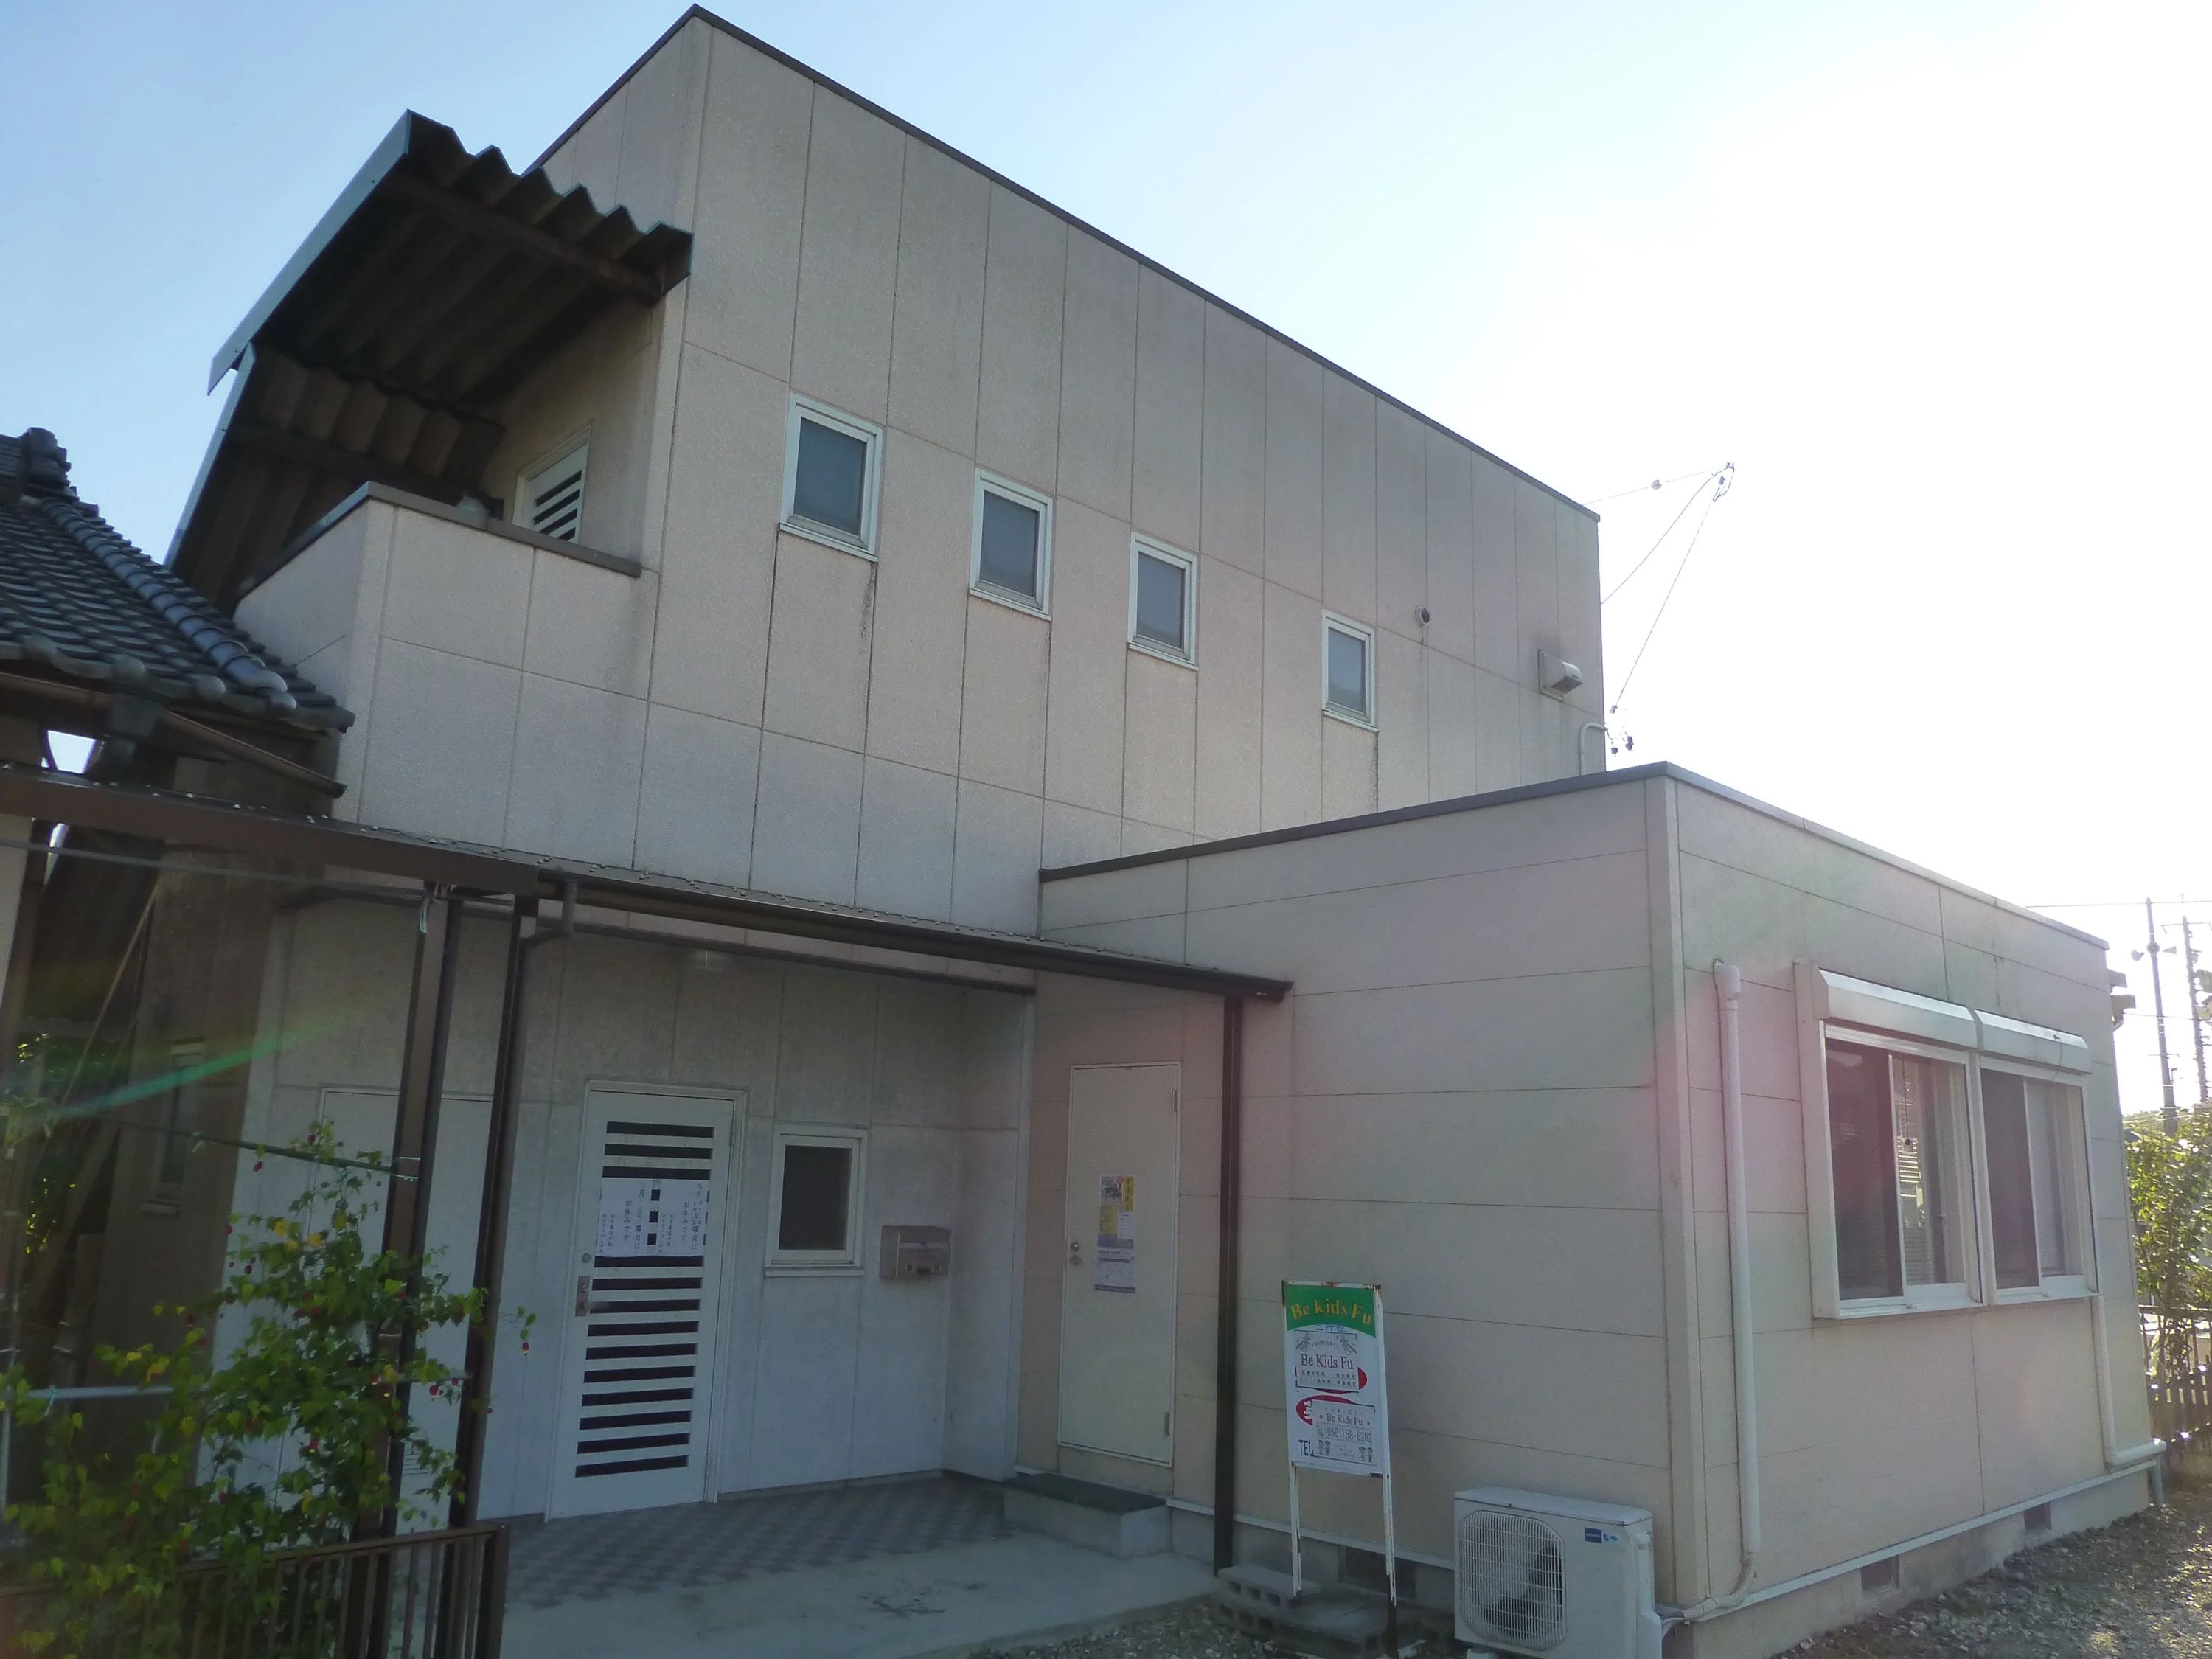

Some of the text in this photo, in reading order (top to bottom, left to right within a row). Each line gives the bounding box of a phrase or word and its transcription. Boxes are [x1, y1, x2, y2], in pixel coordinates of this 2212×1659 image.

[1290, 1303, 1310, 1321] Be
[1352, 1302, 1372, 1325] Fu
[1301, 1353, 1354, 1370] Be Kids Fu
[1326, 1413, 1363, 1426] Be Kids Fu
